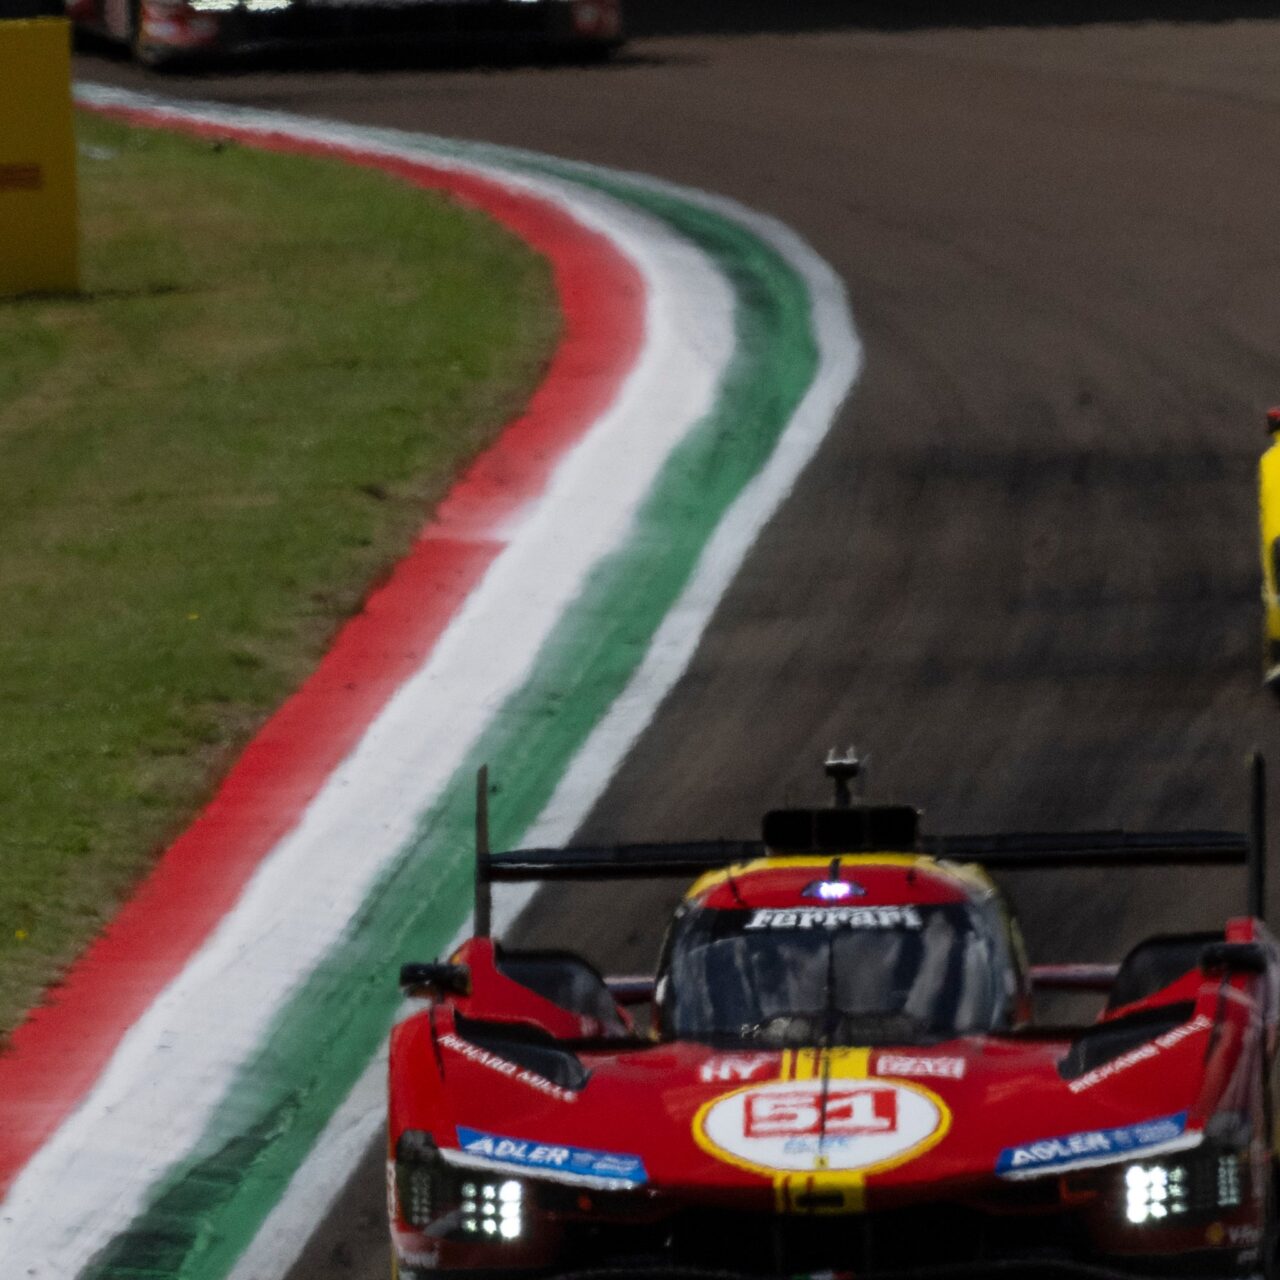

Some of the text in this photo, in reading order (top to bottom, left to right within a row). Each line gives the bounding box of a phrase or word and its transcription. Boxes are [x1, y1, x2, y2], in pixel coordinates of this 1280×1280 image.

[744, 906, 923, 930] Ferrari
[437, 1033, 518, 1077] RICHARD
[750, 1092, 890, 1131] 51
[464, 1136, 570, 1166] ADLER
[1010, 1132, 1111, 1167] ADLER
